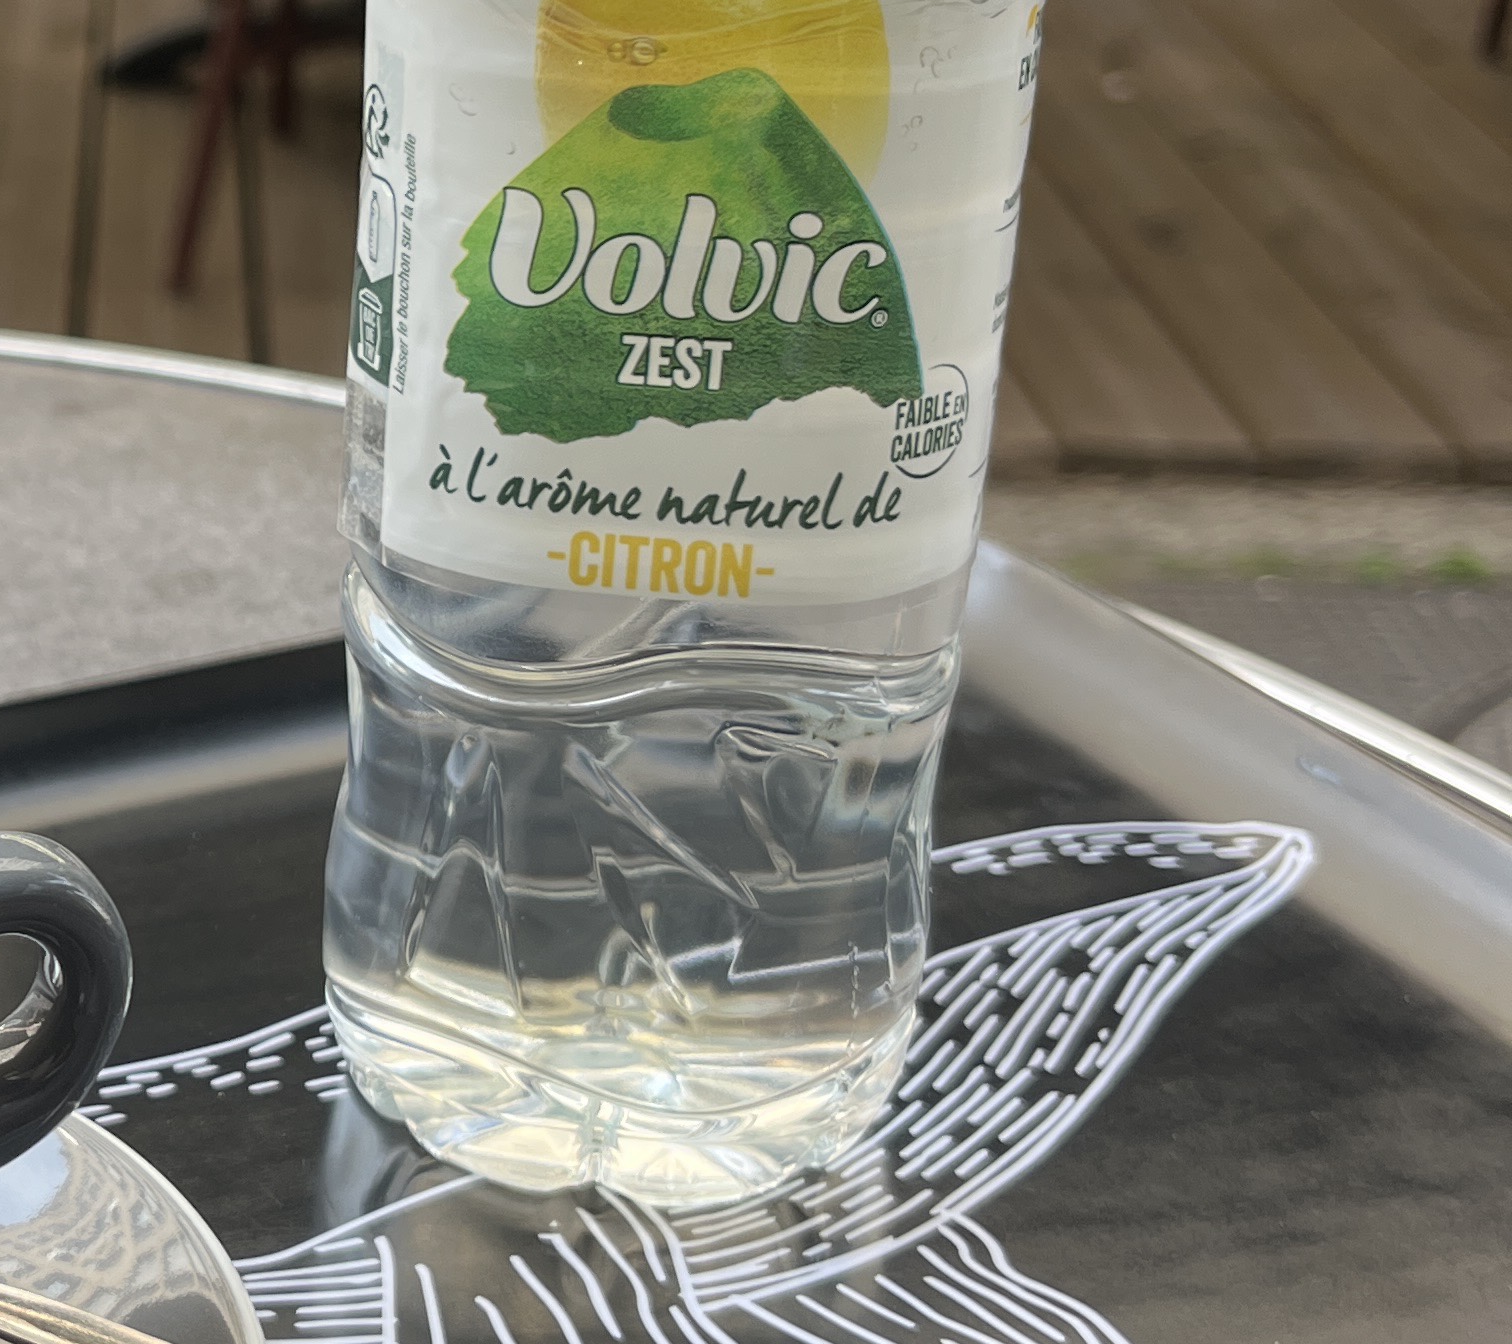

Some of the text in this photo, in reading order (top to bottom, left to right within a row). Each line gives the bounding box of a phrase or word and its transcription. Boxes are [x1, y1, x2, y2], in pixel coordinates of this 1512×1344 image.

[392, 133, 417, 396] Laisser le bouchon sur la bouteille
[489, 185, 888, 325] Volvic
[616, 333, 734, 392] ZEST
[890, 417, 964, 463] CALORIES
[895, 390, 966, 430] FAIBLE EN
[428, 444, 457, 495] à
[656, 468, 845, 531] naturel
[851, 470, 903, 527] de
